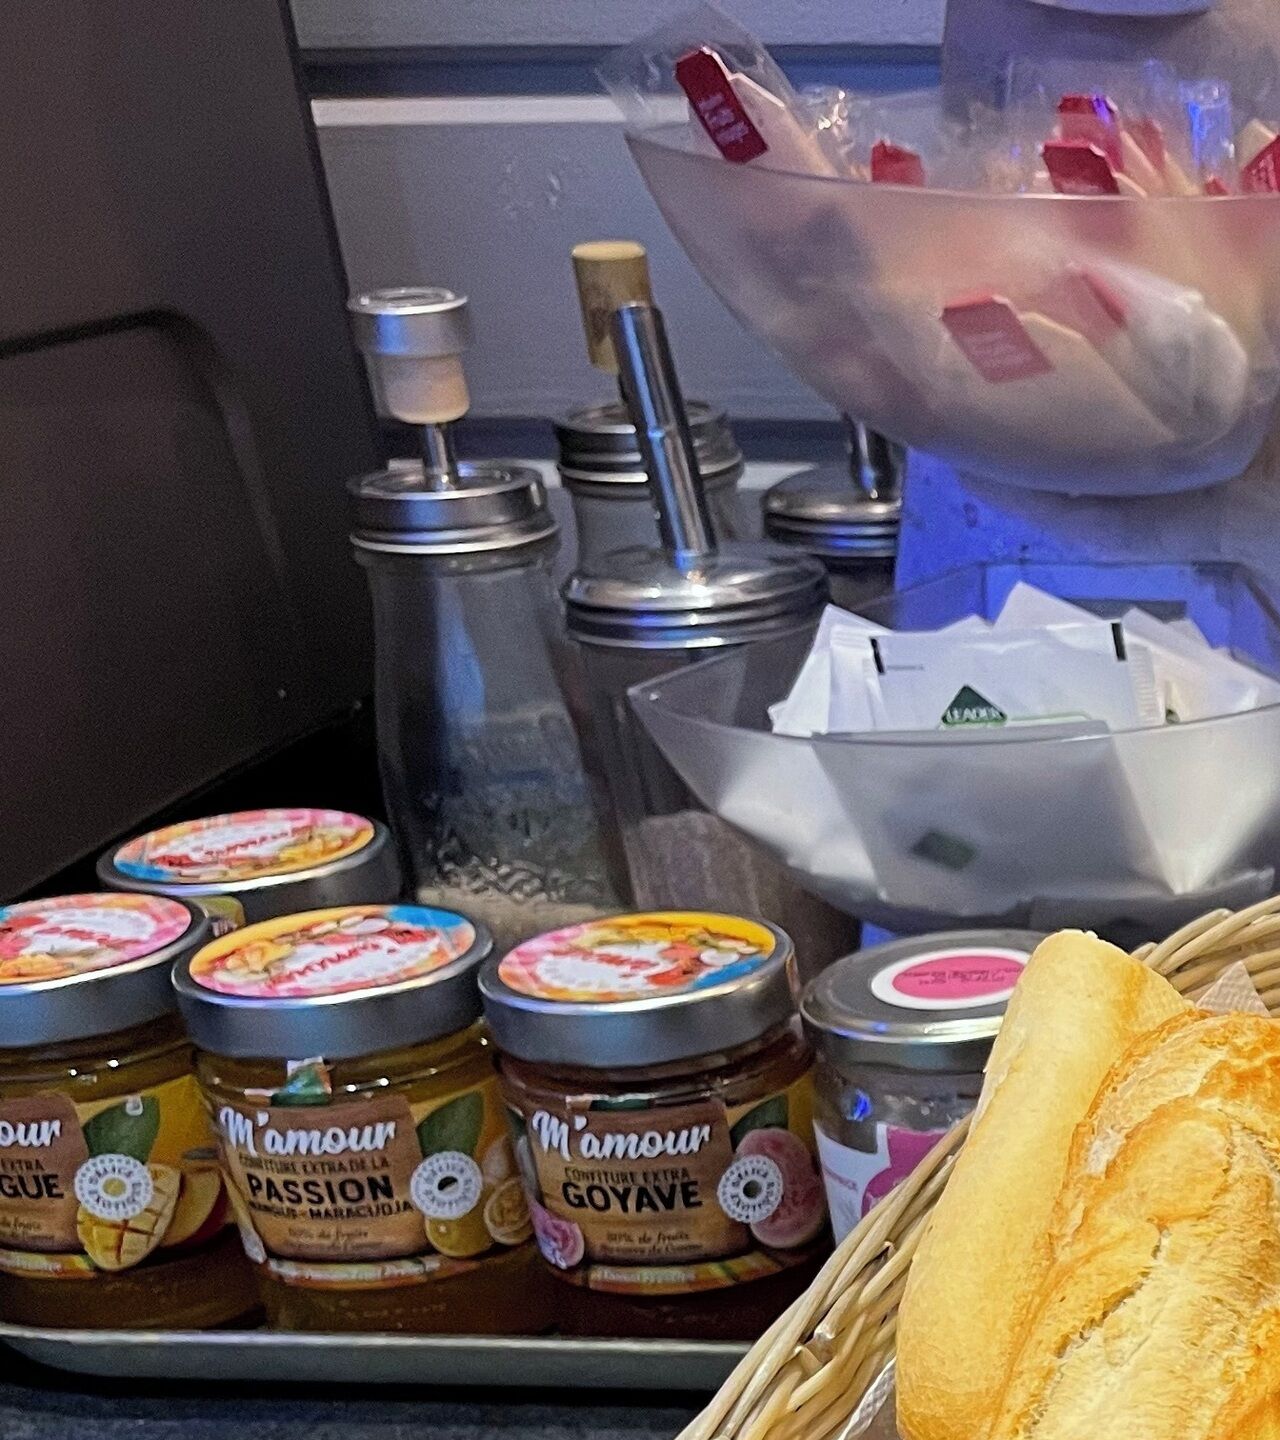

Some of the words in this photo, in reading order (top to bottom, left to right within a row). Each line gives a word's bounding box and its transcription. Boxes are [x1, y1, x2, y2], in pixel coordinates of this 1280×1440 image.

[219, 1106, 397, 1157] M'amour
[532, 1110, 711, 1161] M'amour
[302, 1159, 346, 1175] EXTRA
[564, 1166, 636, 1185] CONFITURE
[642, 1167, 691, 1184] EXTRA
[246, 1172, 394, 1205] PASSION
[561, 1181, 704, 1213] GOYAVE
